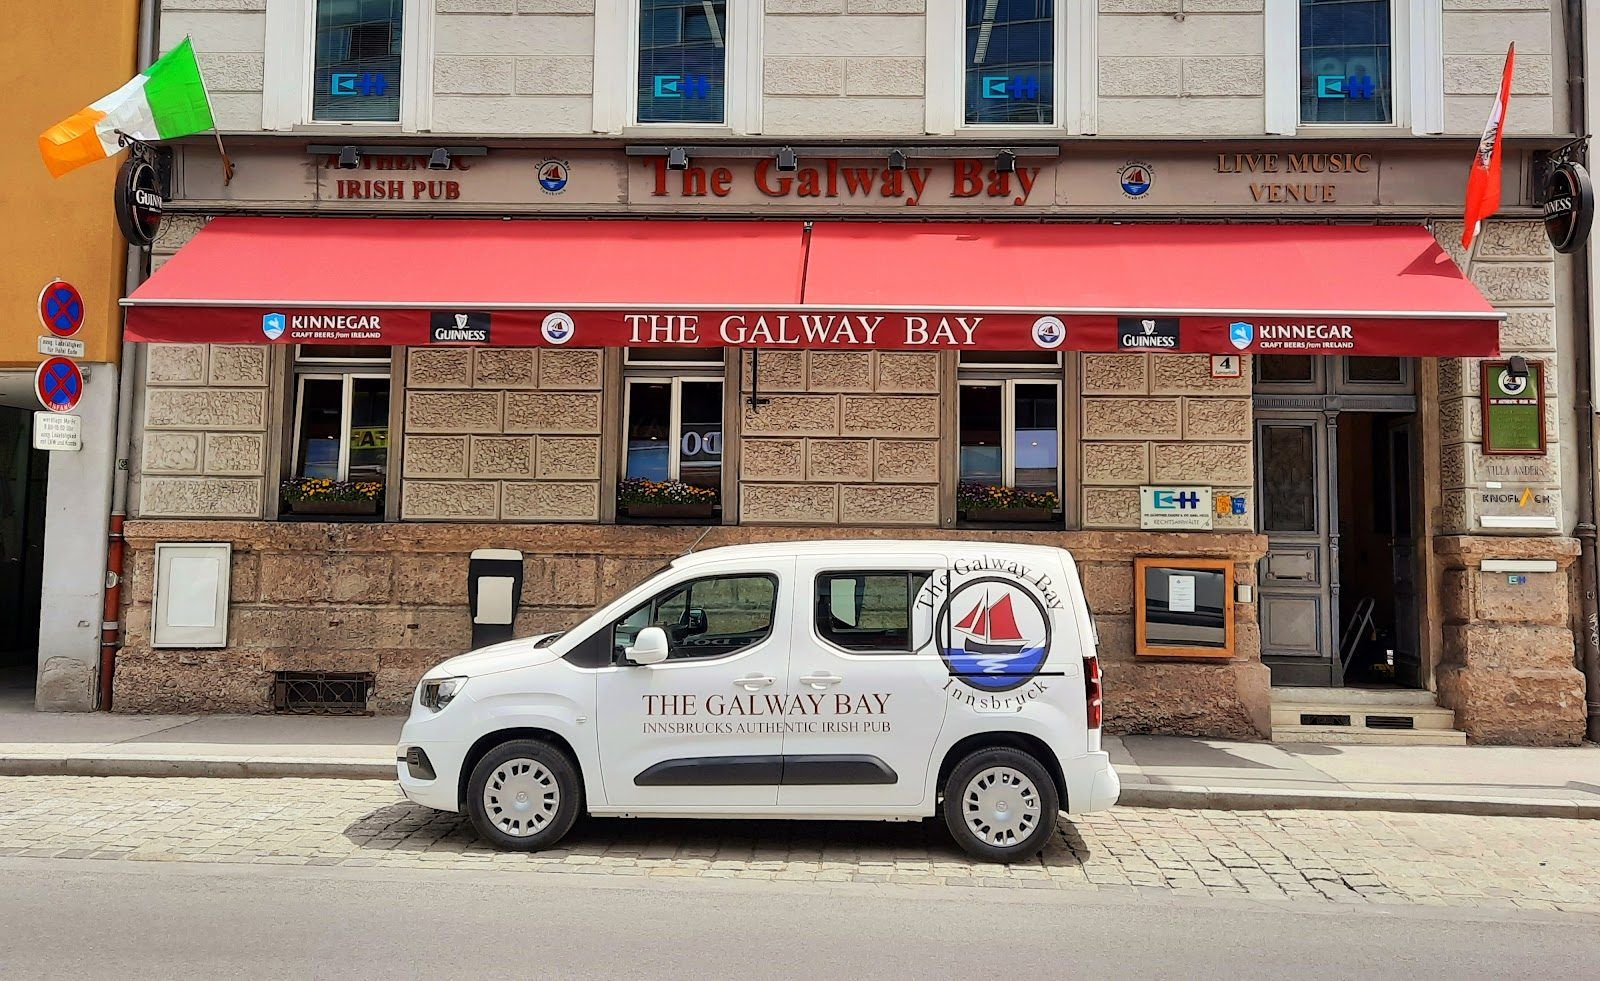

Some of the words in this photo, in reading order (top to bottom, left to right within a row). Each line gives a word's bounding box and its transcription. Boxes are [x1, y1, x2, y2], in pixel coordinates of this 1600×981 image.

[1217, 153, 1279, 173] LIVE
[1287, 153, 1373, 173] MUSIC
[336, 179, 404, 200] IRISH
[412, 180, 461, 200] PUB
[643, 156, 733, 197] The
[755, 157, 932, 206] Galway
[951, 158, 1042, 206] Bay
[1249, 183, 1336, 203] VENUE
[291, 315, 381, 330] KINNEGAR
[624, 314, 700, 343] THE
[719, 314, 885, 344] GALWAY
[903, 316, 984, 345] BAY
[1260, 325, 1353, 339] KINNEGAR
[434, 327, 486, 341] GUINNESS
[1122, 334, 1175, 347] GUINNESS
[1220, 357, 1231, 369] 4
[916, 574, 952, 611] The
[954, 554, 1032, 579] Galway
[1034, 573, 1065, 611] Bay
[642, 694, 697, 716] THE
[705, 693, 827, 716] GALWAY
[834, 693, 892, 715] BAY
[942, 679, 1049, 710] Innsbruck
[643, 722, 733, 734] INNSBRUCKS
[736, 722, 818, 734] AUTHENTIC
[822, 722, 860, 733] IRISH
[863, 721, 892, 733] PUB
